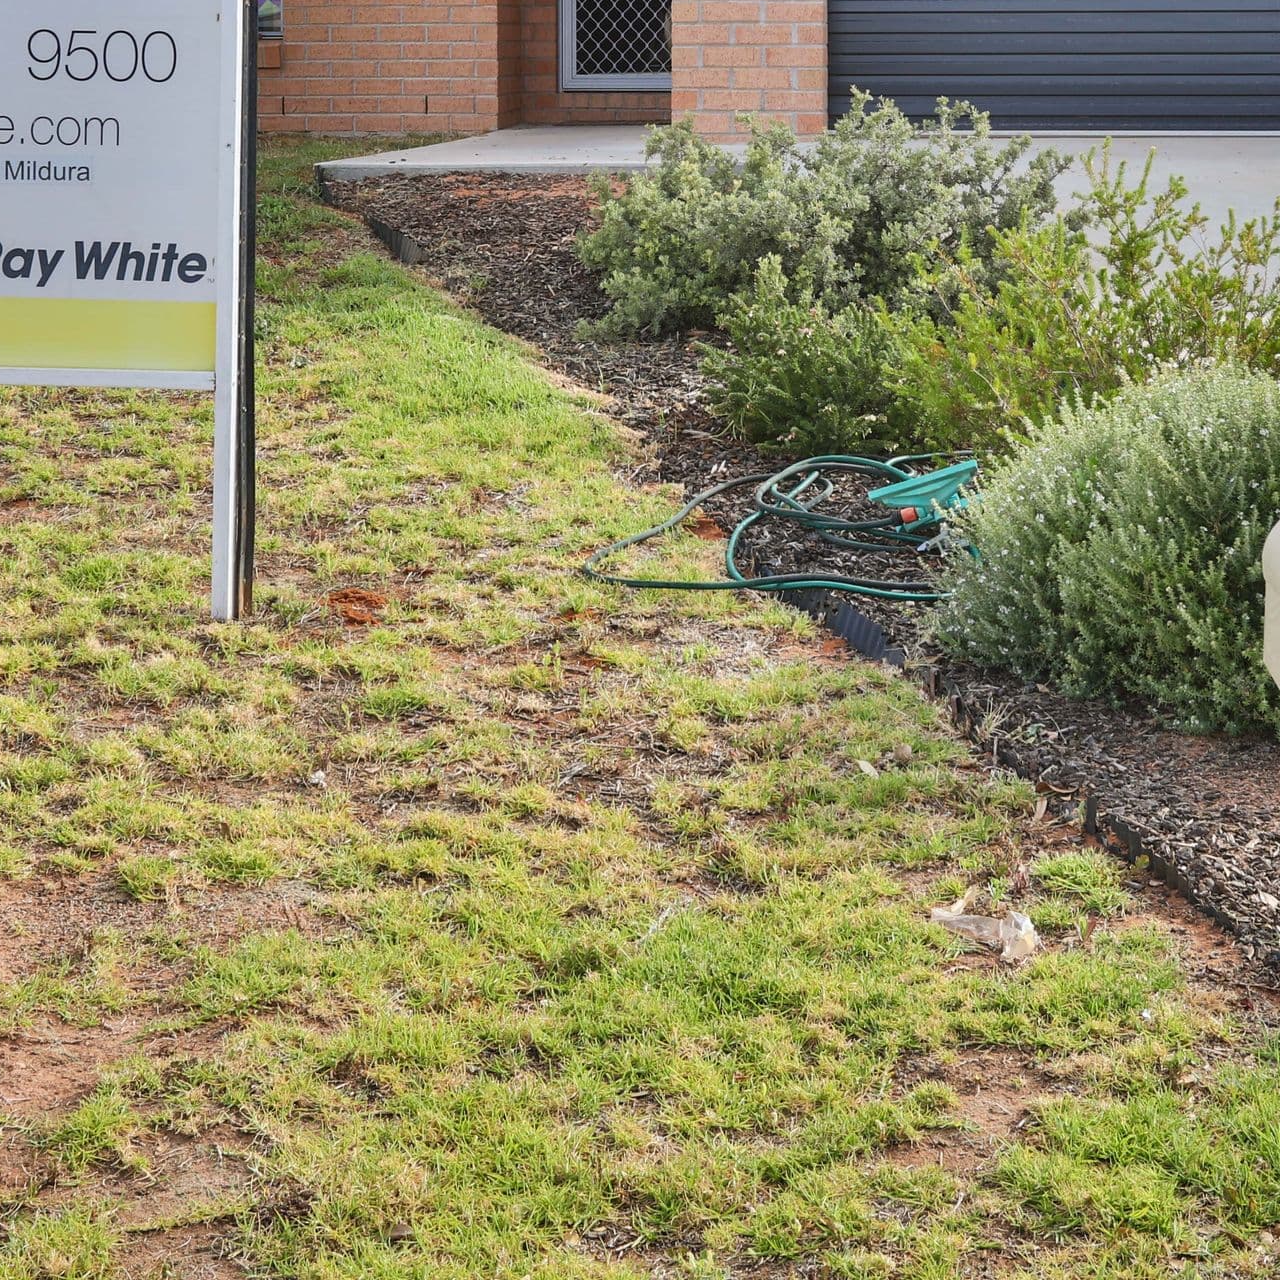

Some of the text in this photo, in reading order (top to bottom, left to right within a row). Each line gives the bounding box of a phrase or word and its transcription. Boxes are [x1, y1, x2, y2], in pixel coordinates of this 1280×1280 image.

[27, 29, 178, 83] 9500
[4, 160, 91, 182] Mildura
[74, 241, 208, 284] White
